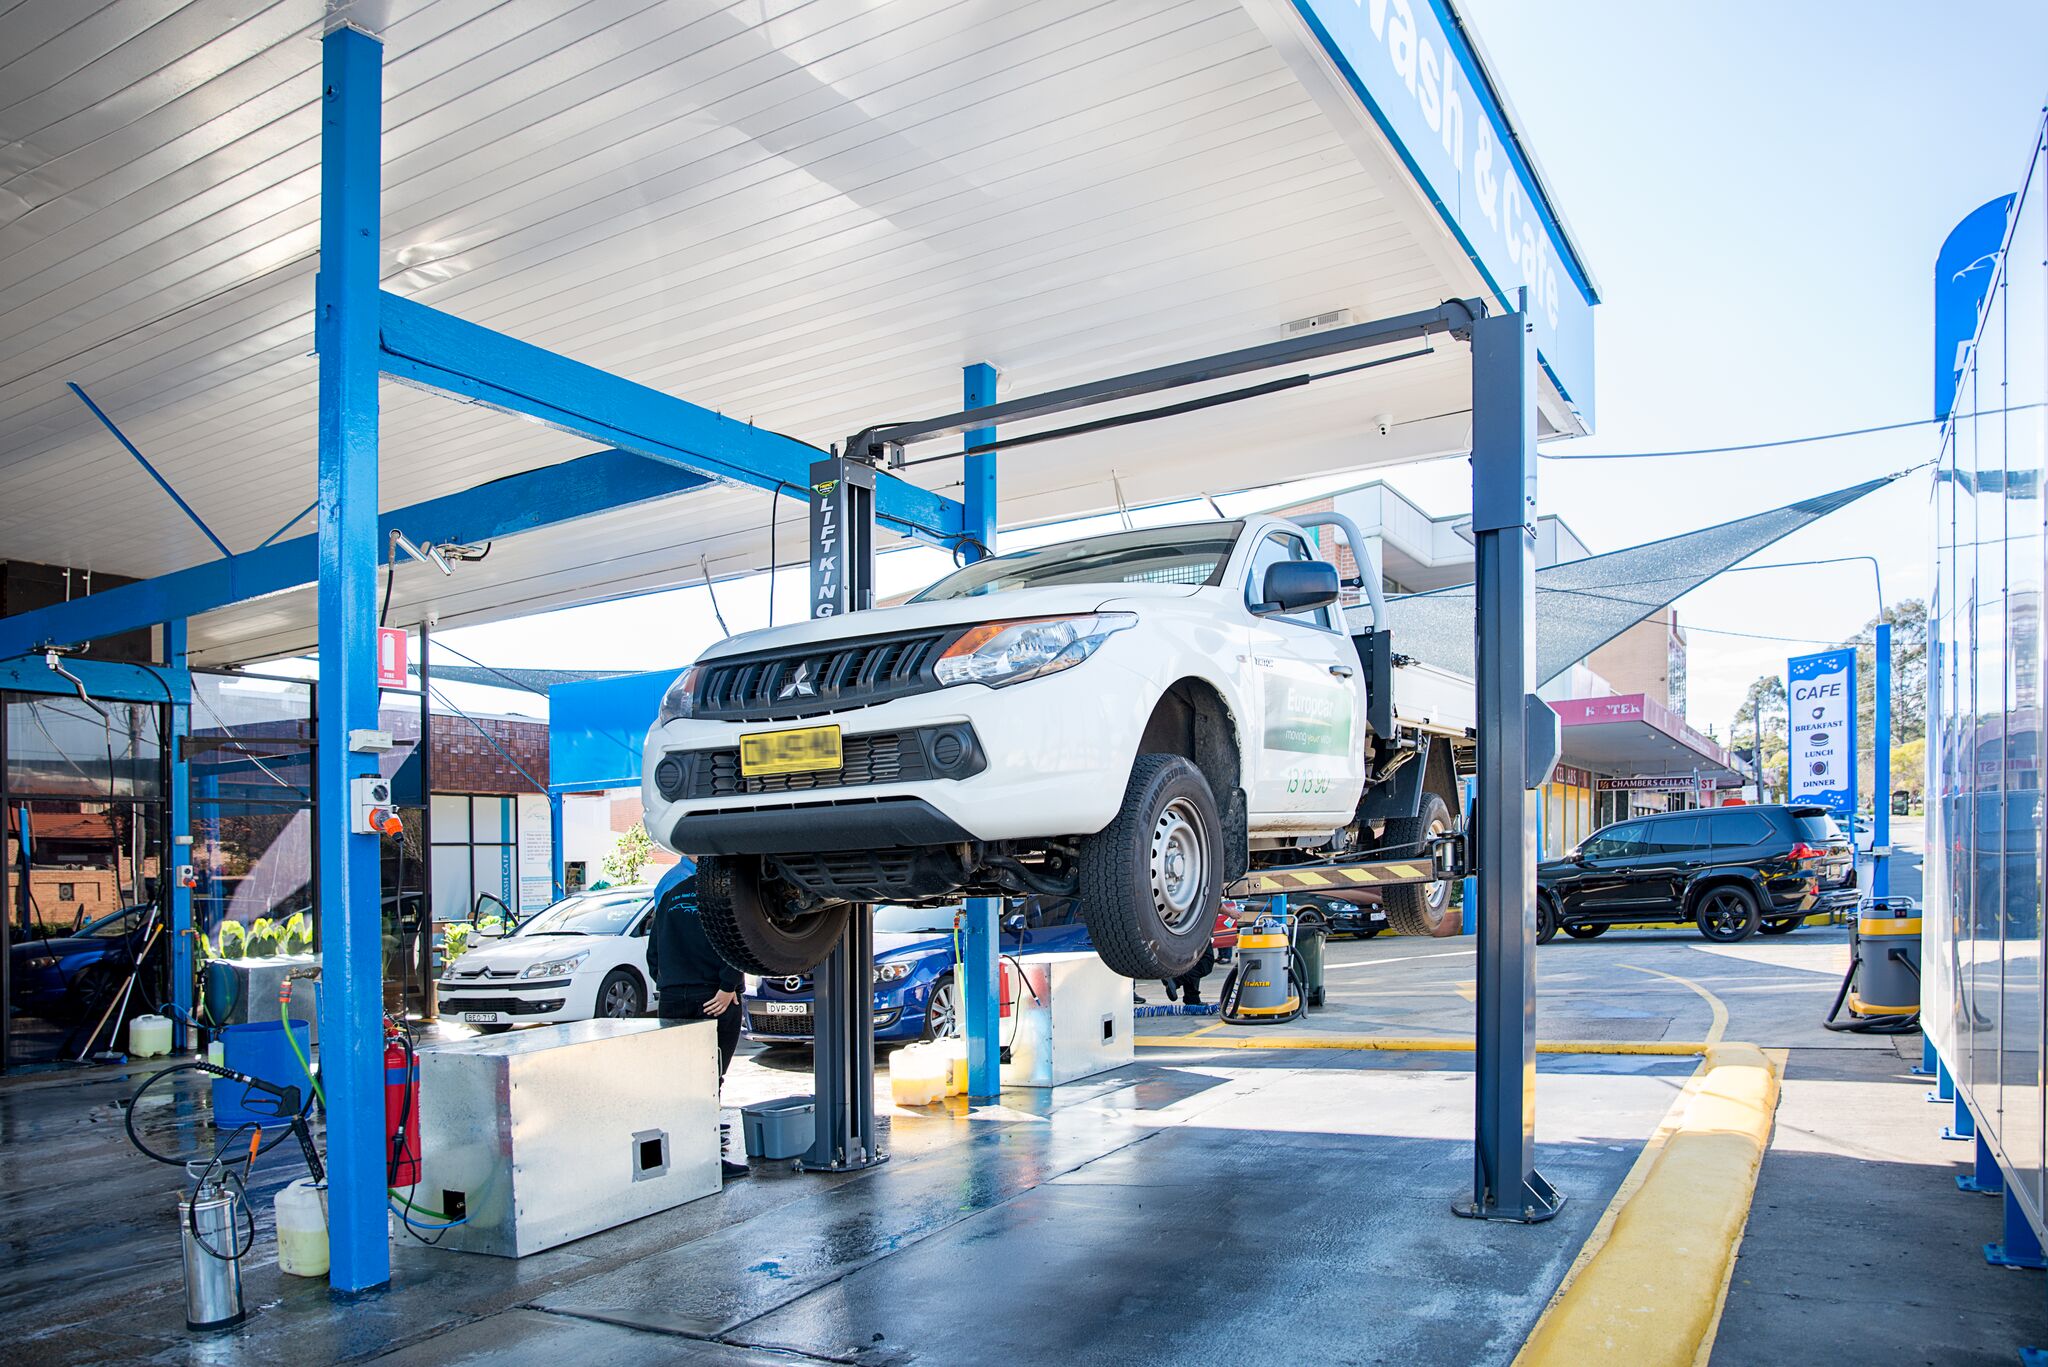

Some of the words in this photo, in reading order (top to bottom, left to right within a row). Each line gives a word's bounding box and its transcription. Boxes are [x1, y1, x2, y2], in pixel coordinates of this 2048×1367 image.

[1356, 0, 1464, 176] ash
[1474, 114, 1498, 232] &
[1503, 168, 1559, 331] Cafe
[1795, 683, 1841, 701] CAFE
[1795, 720, 1843, 732] BREAKFAST
[1805, 749, 1834, 758] LUNCH
[1611, 779, 1658, 788] CHAMBERS
[1803, 779, 1836, 788] DINNER
